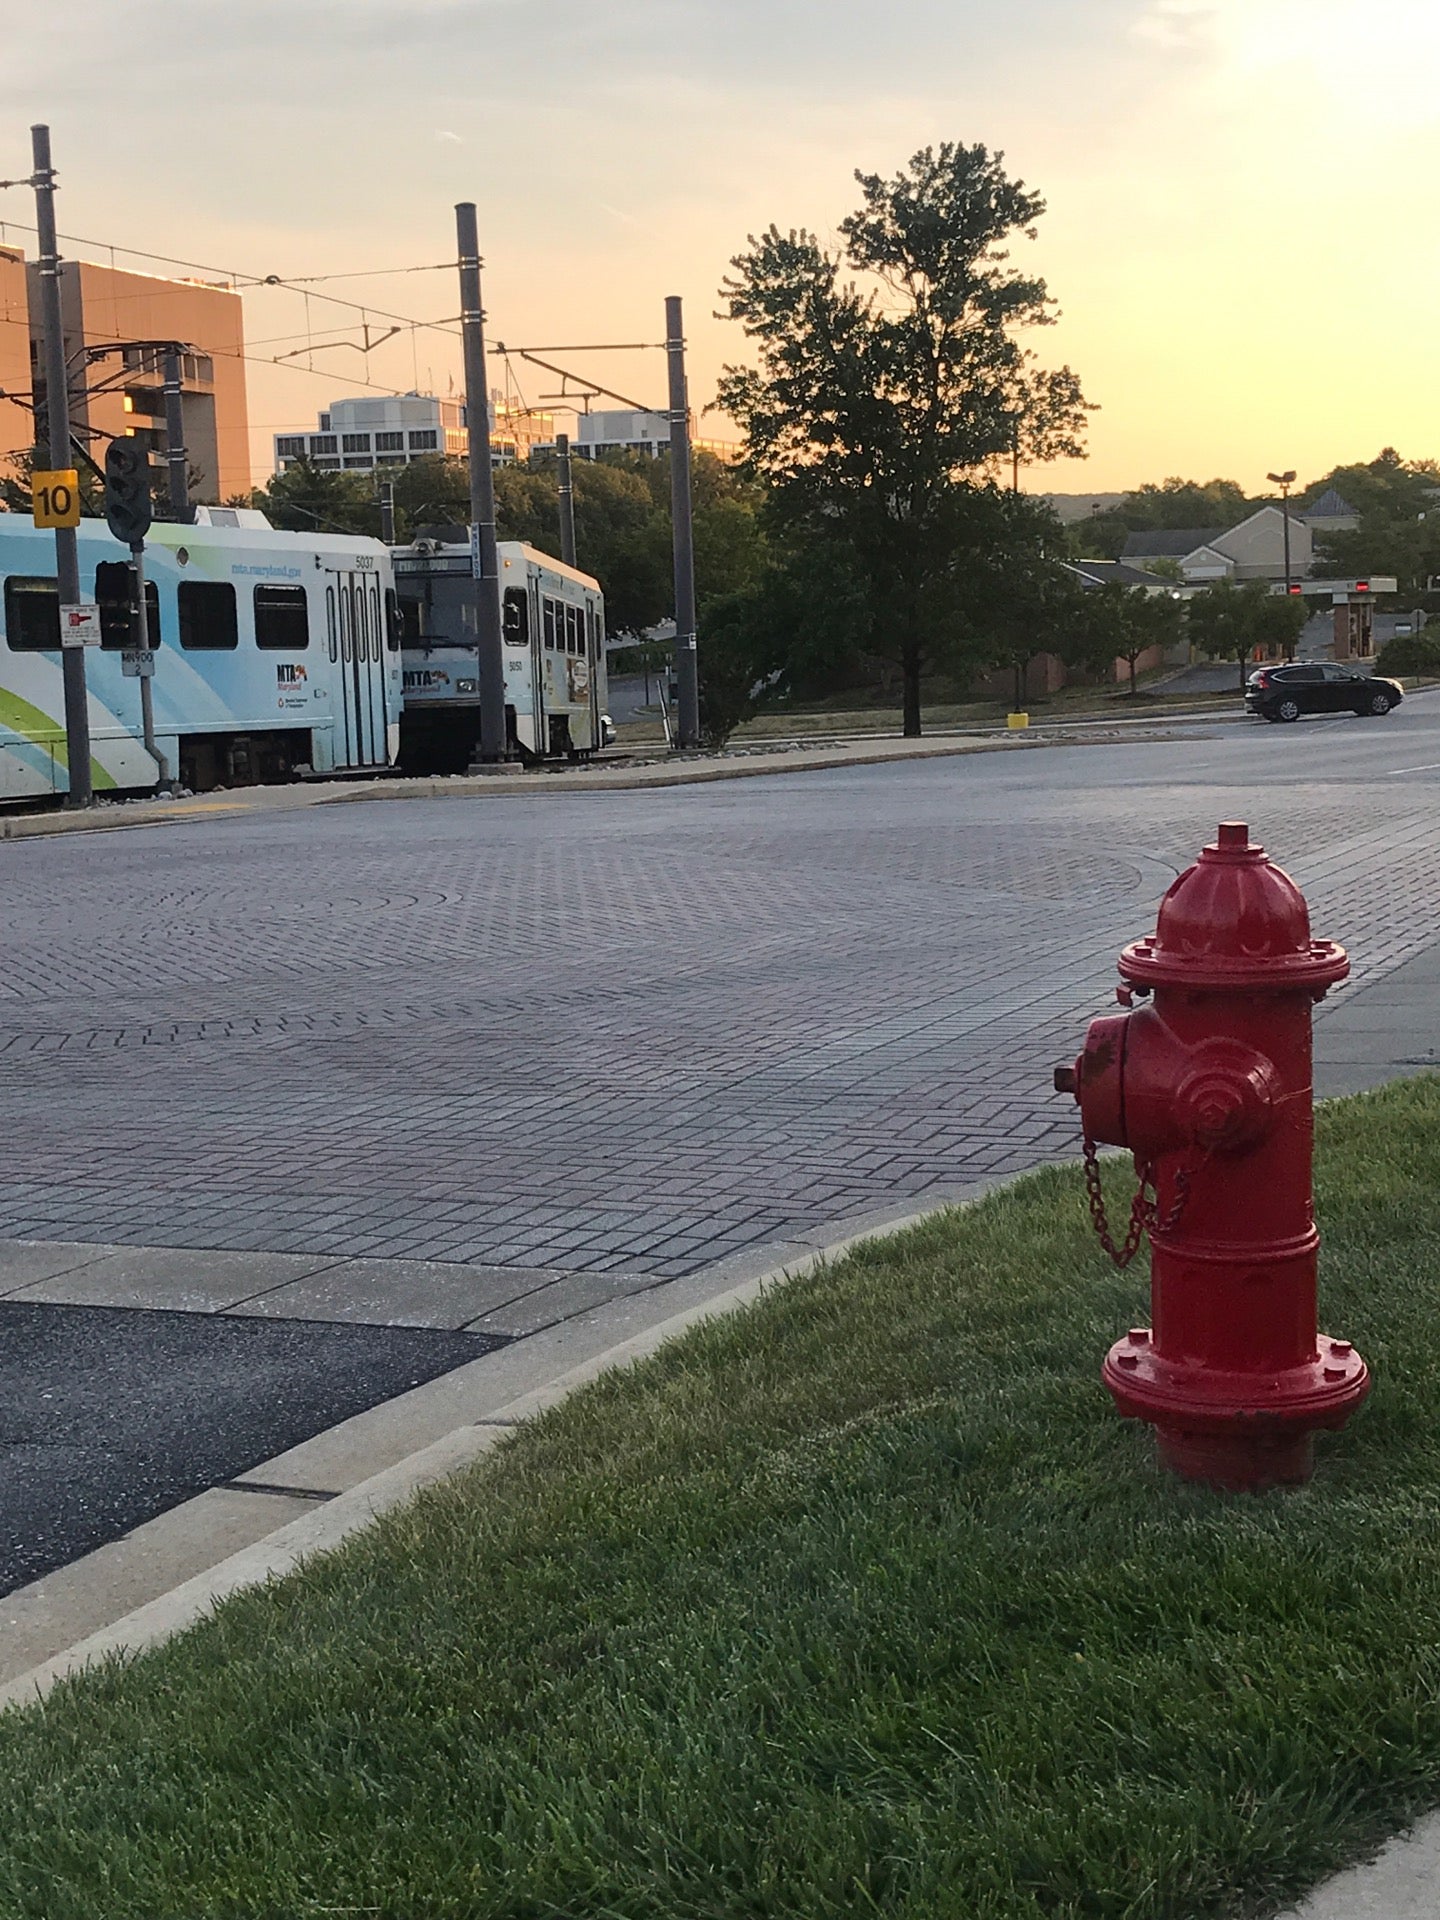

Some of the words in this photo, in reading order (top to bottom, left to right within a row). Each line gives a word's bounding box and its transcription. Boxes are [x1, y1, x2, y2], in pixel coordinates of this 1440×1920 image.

[37, 485, 71, 516] 10
[355, 556, 374, 569] 5037
[135, 664, 141, 675] 2
[277, 664, 296, 682] MTA
[403, 670, 432, 686] MTA
